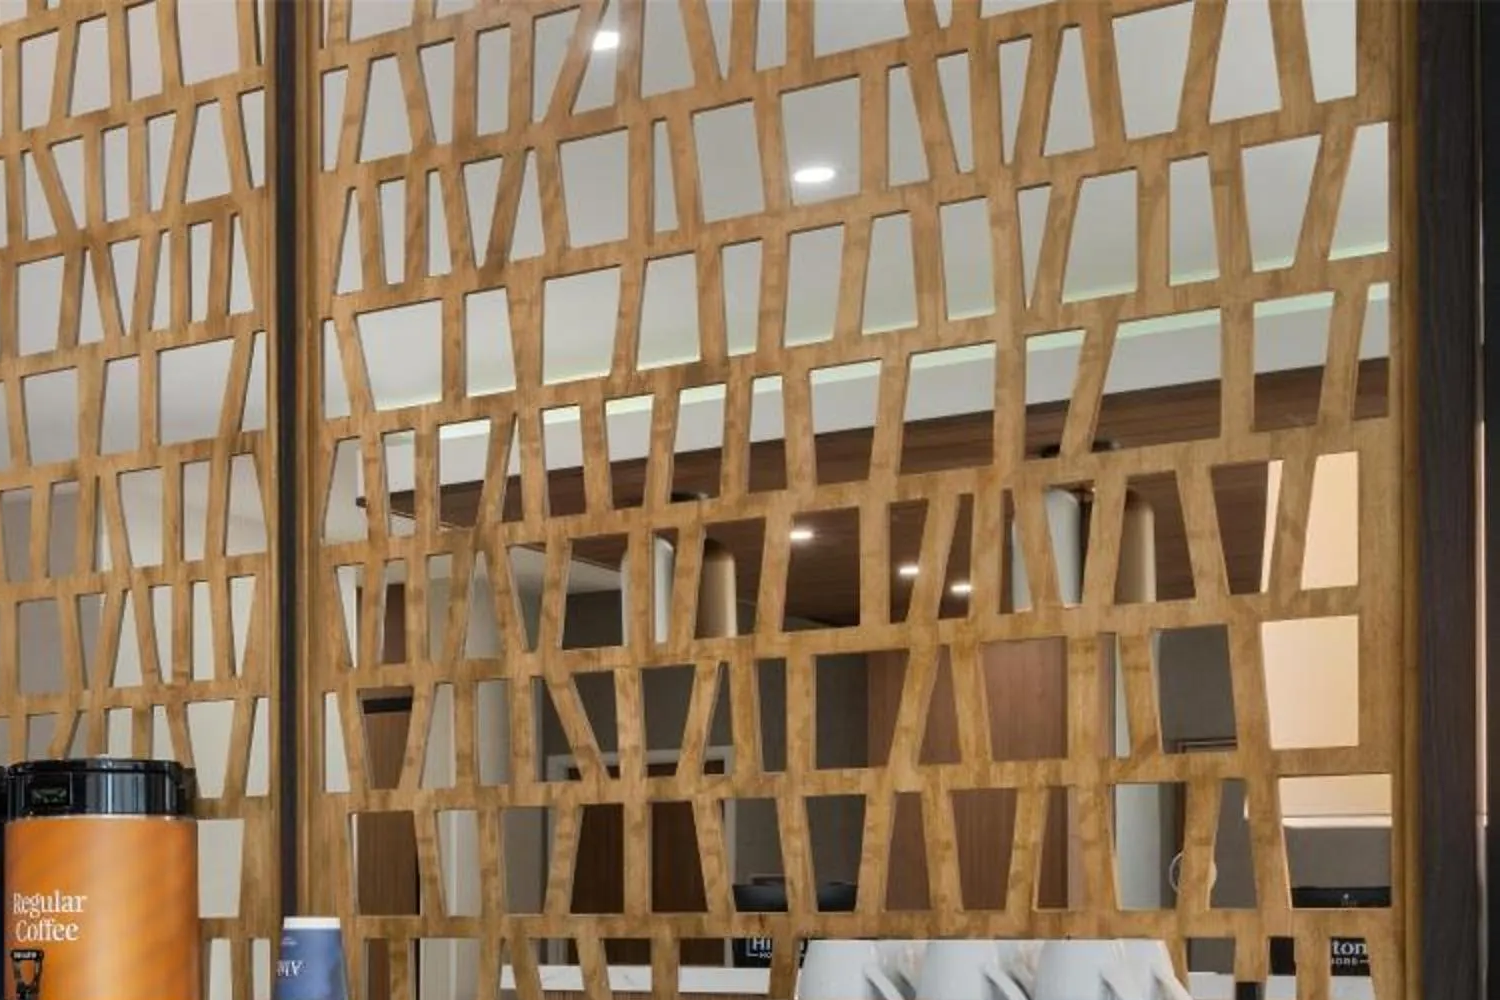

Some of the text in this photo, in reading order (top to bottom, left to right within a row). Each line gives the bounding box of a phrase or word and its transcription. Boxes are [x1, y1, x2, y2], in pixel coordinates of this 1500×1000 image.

[13, 890, 87, 917] Regular
[15, 918, 80, 942] Coffee
[1332, 940, 1368, 955] ton
